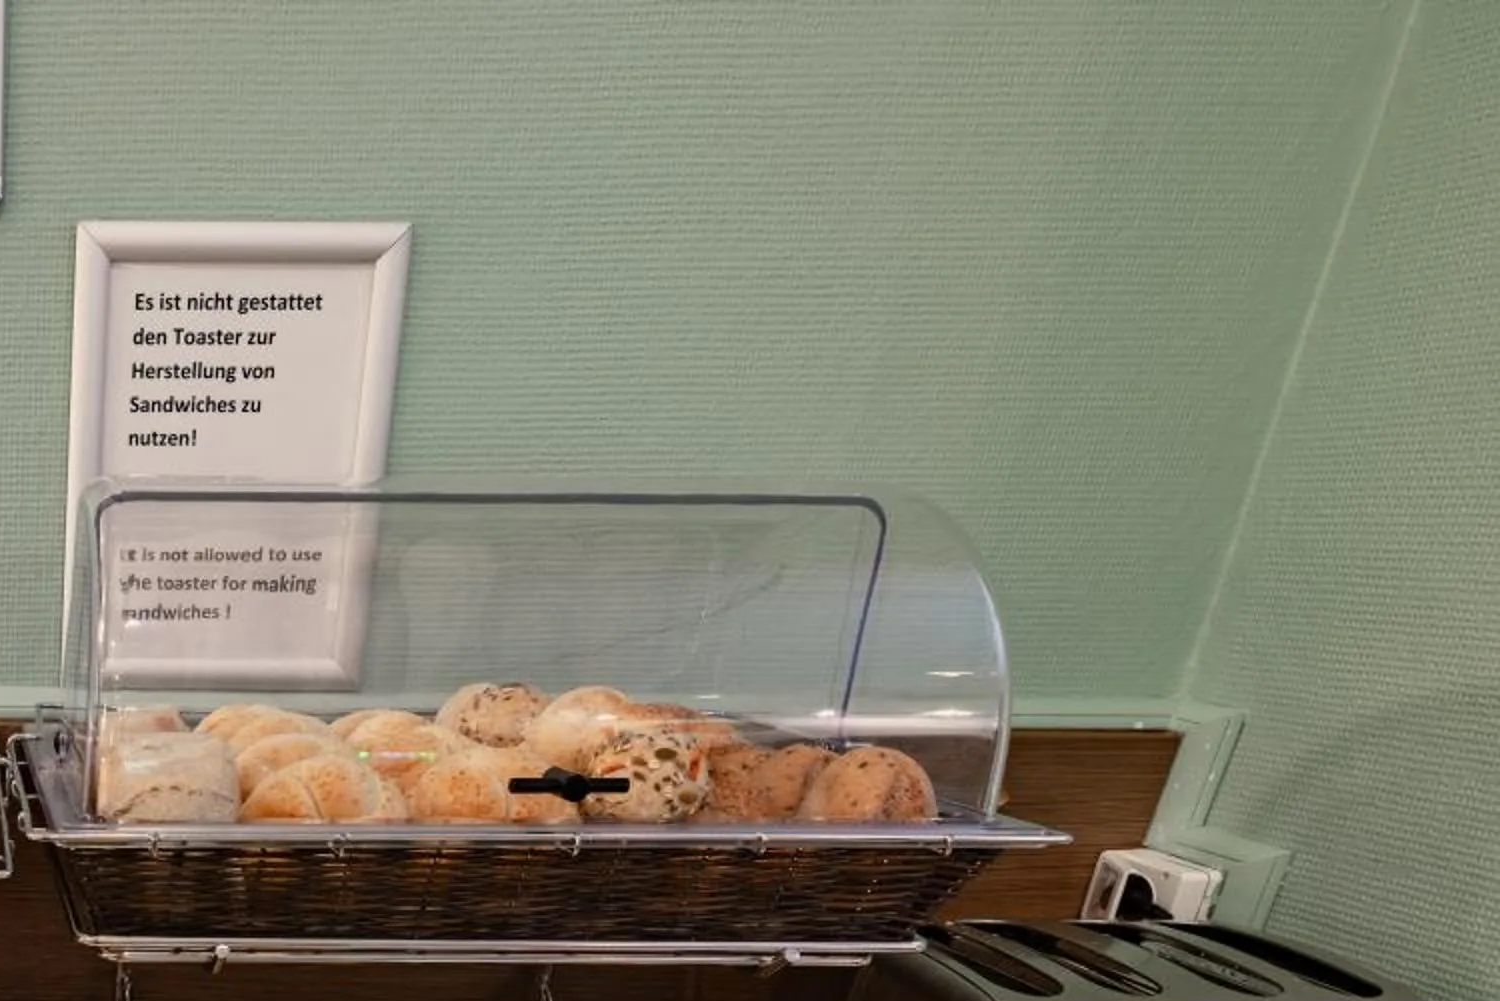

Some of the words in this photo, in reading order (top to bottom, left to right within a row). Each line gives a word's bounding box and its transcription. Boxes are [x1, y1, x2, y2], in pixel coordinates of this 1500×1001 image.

[134, 292, 154, 310] Es
[159, 292, 181, 310] ist
[187, 291, 233, 310] nicht
[237, 294, 322, 314] gestattet
[132, 327, 166, 345] den
[173, 327, 242, 345] Toaster
[247, 331, 276, 345] zur
[131, 361, 236, 383] Herstellung
[241, 366, 274, 379] von
[129, 395, 236, 413] Sandwiches
[241, 399, 261, 412] zu
[128, 428, 196, 446] nutzen!
[141, 548, 154, 561] is
[160, 550, 188, 561] not
[193, 547, 262, 562] allowed
[269, 548, 287, 561] to
[292, 550, 322, 561] use
[157, 576, 217, 591] toaster
[222, 575, 246, 591] for
[252, 574, 316, 594] making
